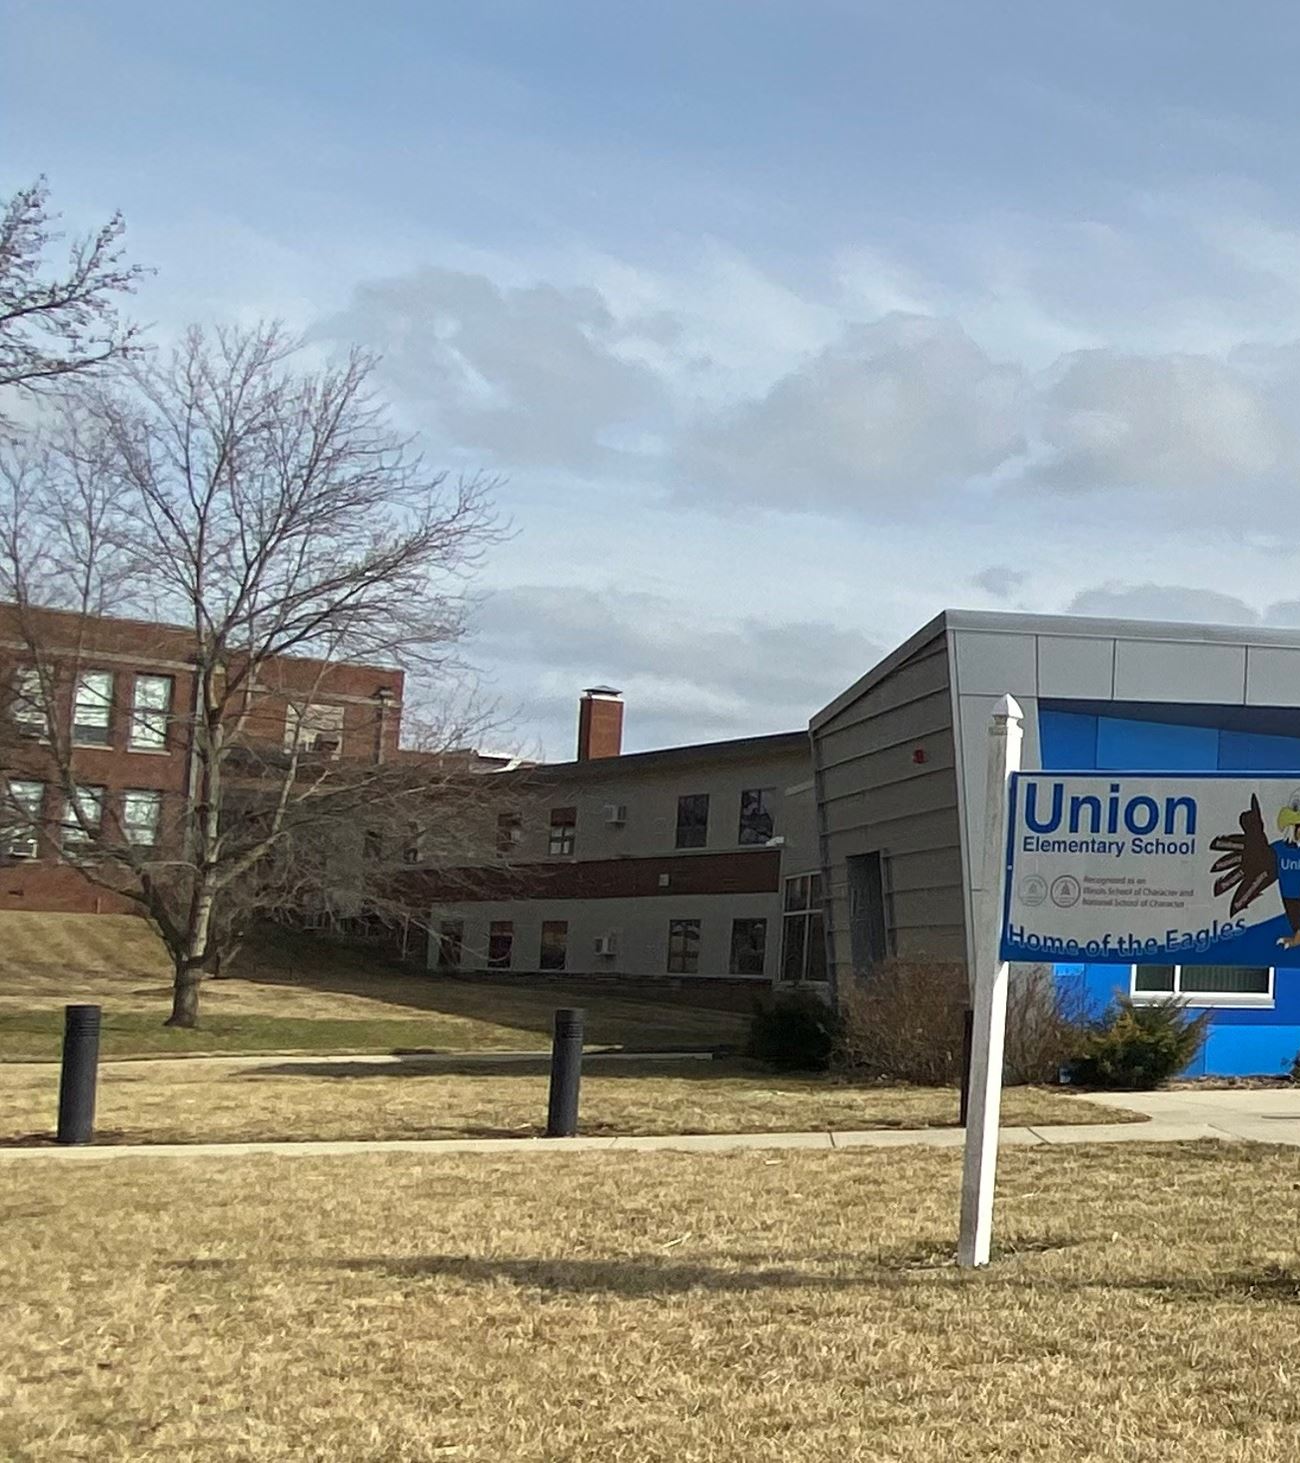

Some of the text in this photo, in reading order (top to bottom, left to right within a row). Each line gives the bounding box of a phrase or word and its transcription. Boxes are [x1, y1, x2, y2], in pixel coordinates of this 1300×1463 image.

[1025, 782, 1197, 835] Union
[1023, 836, 1195, 857] Elementary School
[1008, 917, 1248, 957] Home of the Eagles
